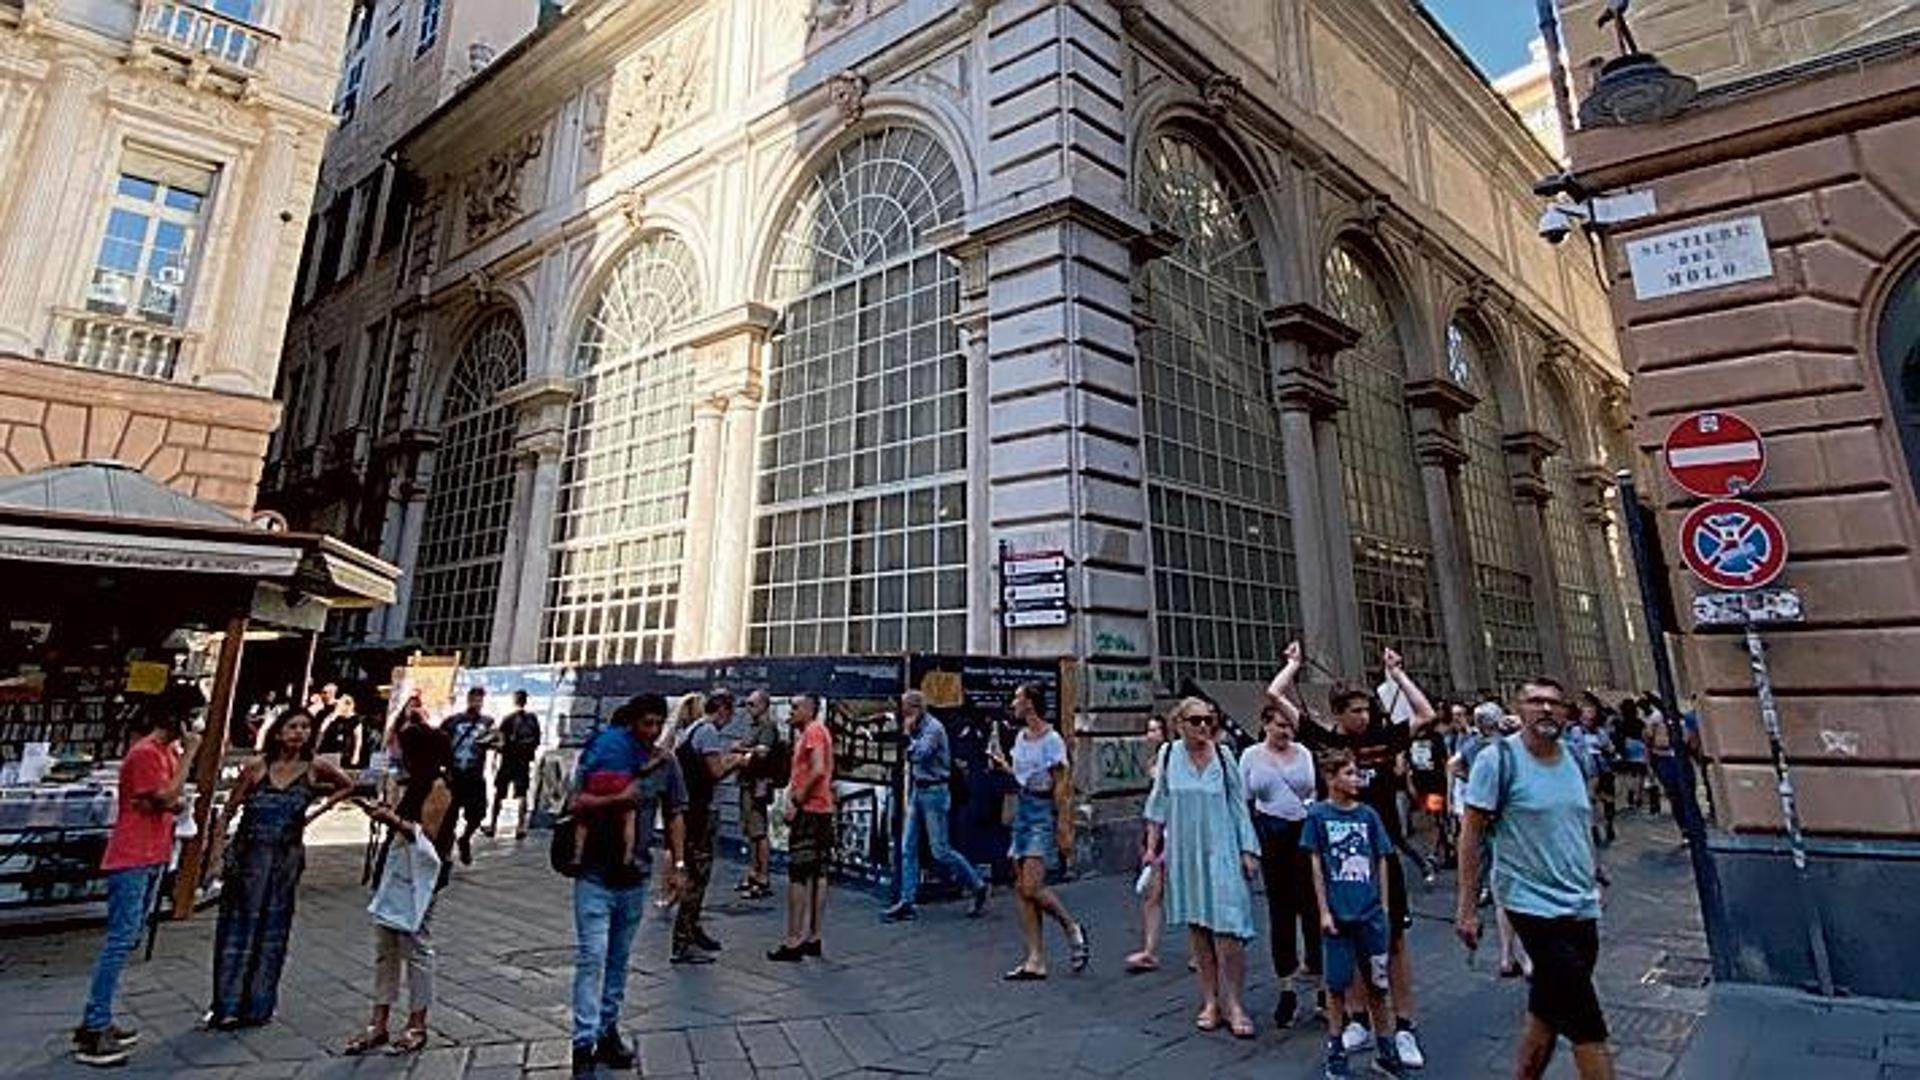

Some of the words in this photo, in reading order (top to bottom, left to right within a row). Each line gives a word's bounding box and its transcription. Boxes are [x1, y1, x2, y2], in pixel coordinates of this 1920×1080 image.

[1641, 225, 1750, 255] SESTIERE
[1679, 248, 1715, 265] DEL
[1667, 263, 1736, 286] MOLO
